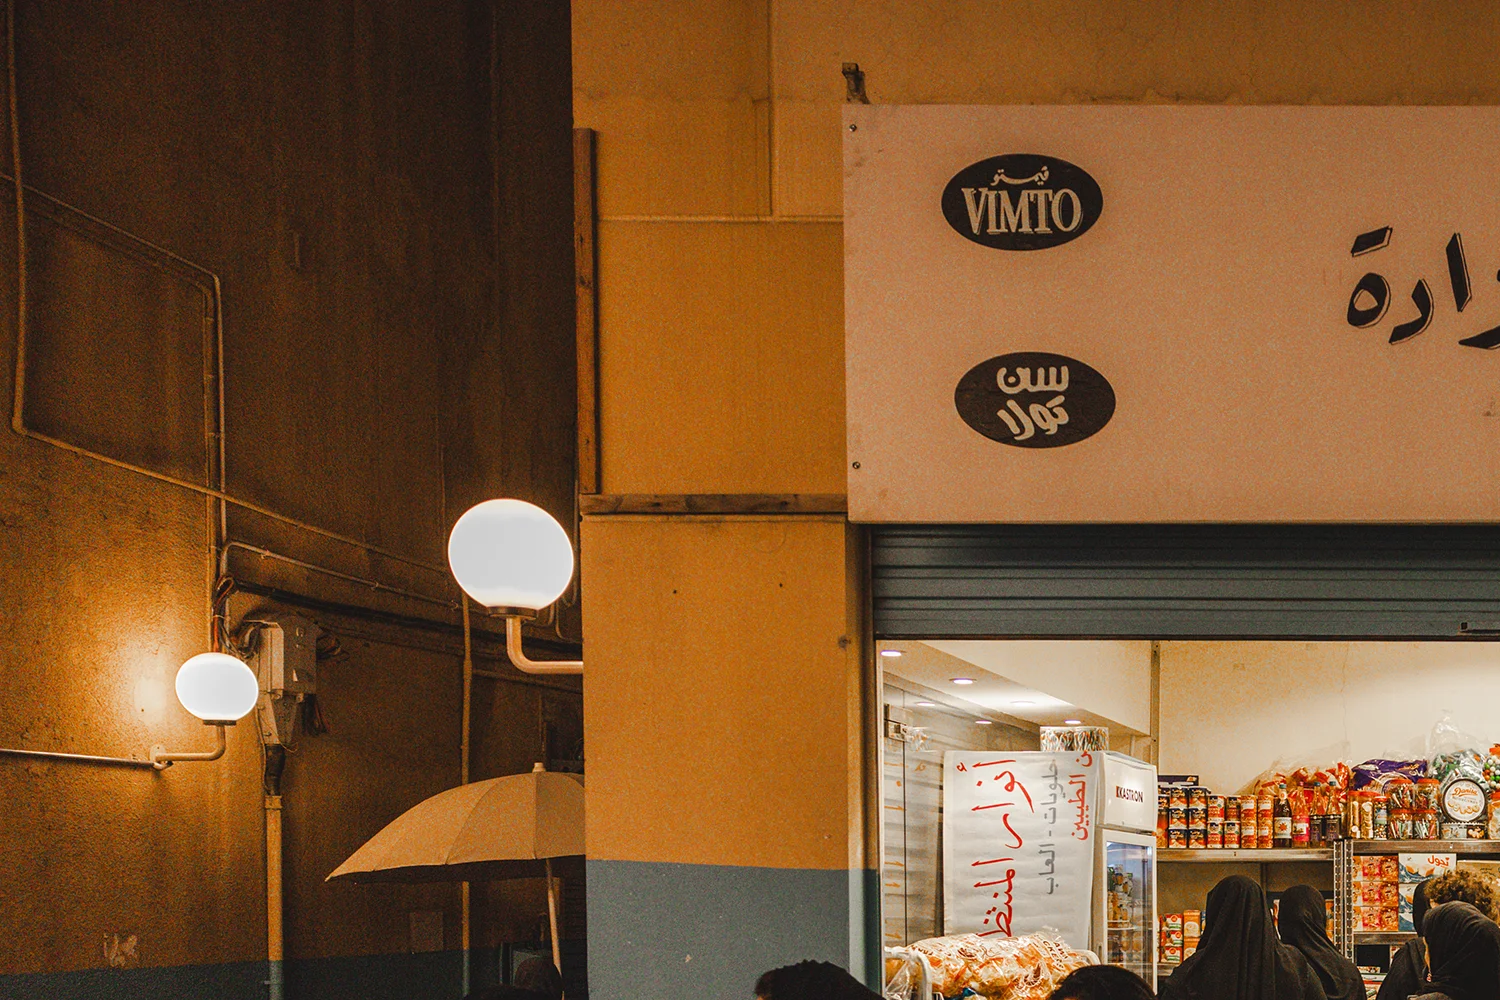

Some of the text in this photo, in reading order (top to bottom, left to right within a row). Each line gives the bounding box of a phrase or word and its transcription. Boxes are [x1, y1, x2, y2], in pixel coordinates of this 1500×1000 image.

[961, 187, 1083, 235] VIMTO
[996, 366, 1069, 394] سن
[996, 395, 1069, 441] كولا
